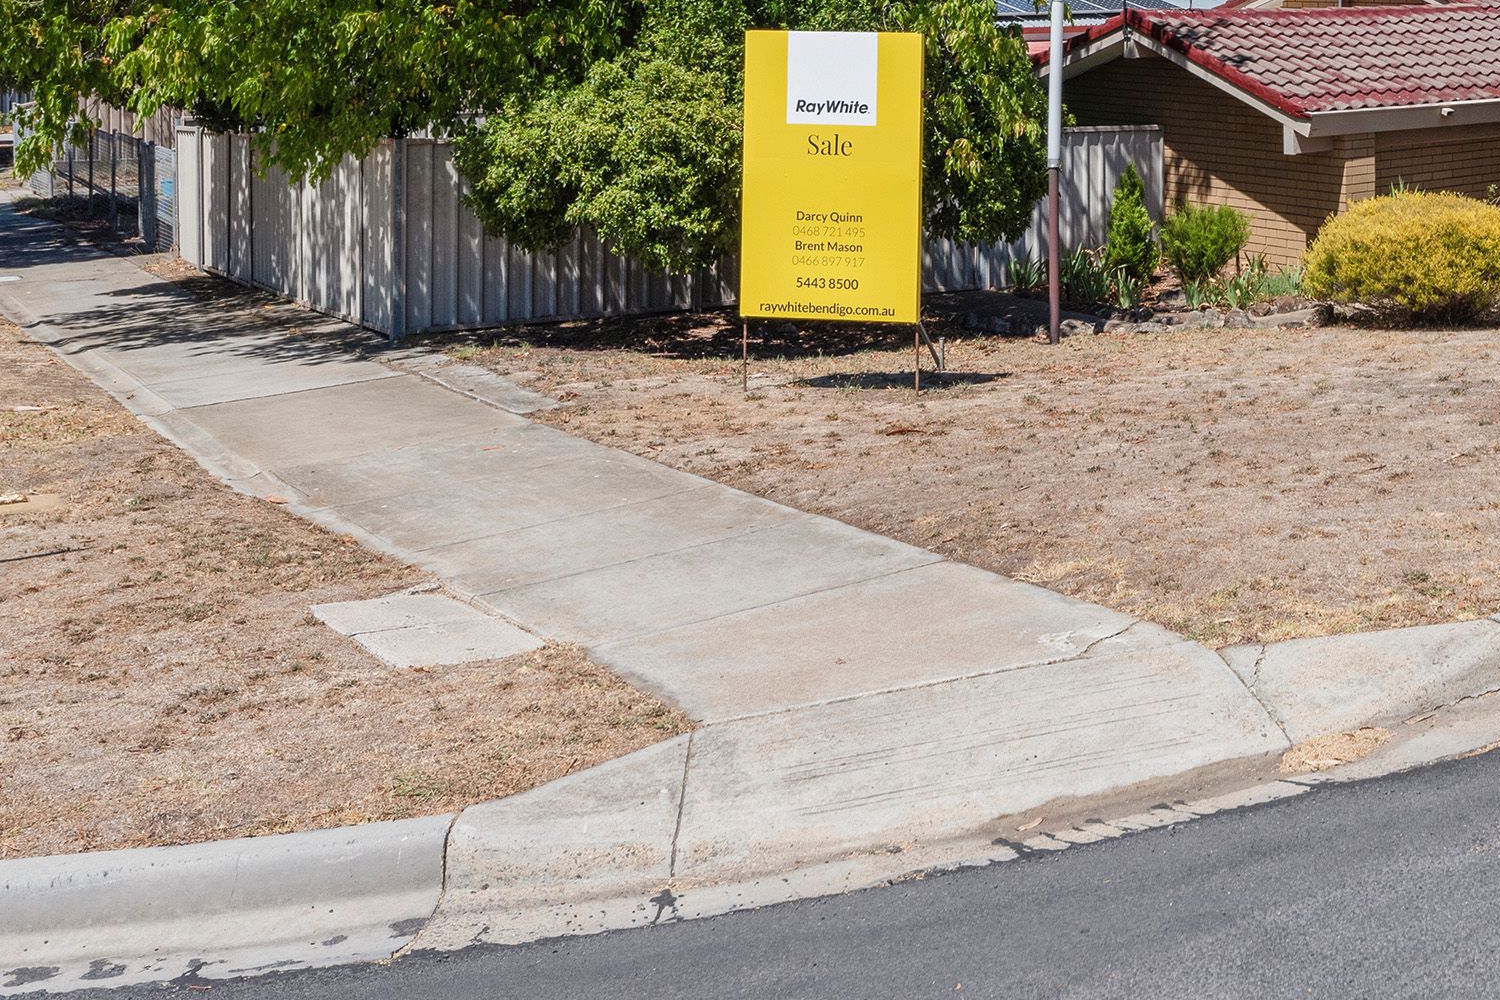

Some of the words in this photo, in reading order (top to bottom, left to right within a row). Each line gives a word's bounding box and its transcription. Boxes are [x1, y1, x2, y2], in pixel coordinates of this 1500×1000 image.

[807, 134, 852, 156] Sale
[796, 211, 827, 223] Darcy
[830, 212, 863, 223] Quinn
[792, 225, 820, 236] 0468
[845, 227, 866, 238] 495
[795, 241, 824, 251] Brent
[827, 242, 863, 252] Mason
[791, 255, 820, 266] 0466
[822, 256, 843, 267] 897
[796, 277, 826, 289] 5443
[828, 278, 859, 290] 8500
[760, 302, 895, 317] raywhitebendigo.com.au
